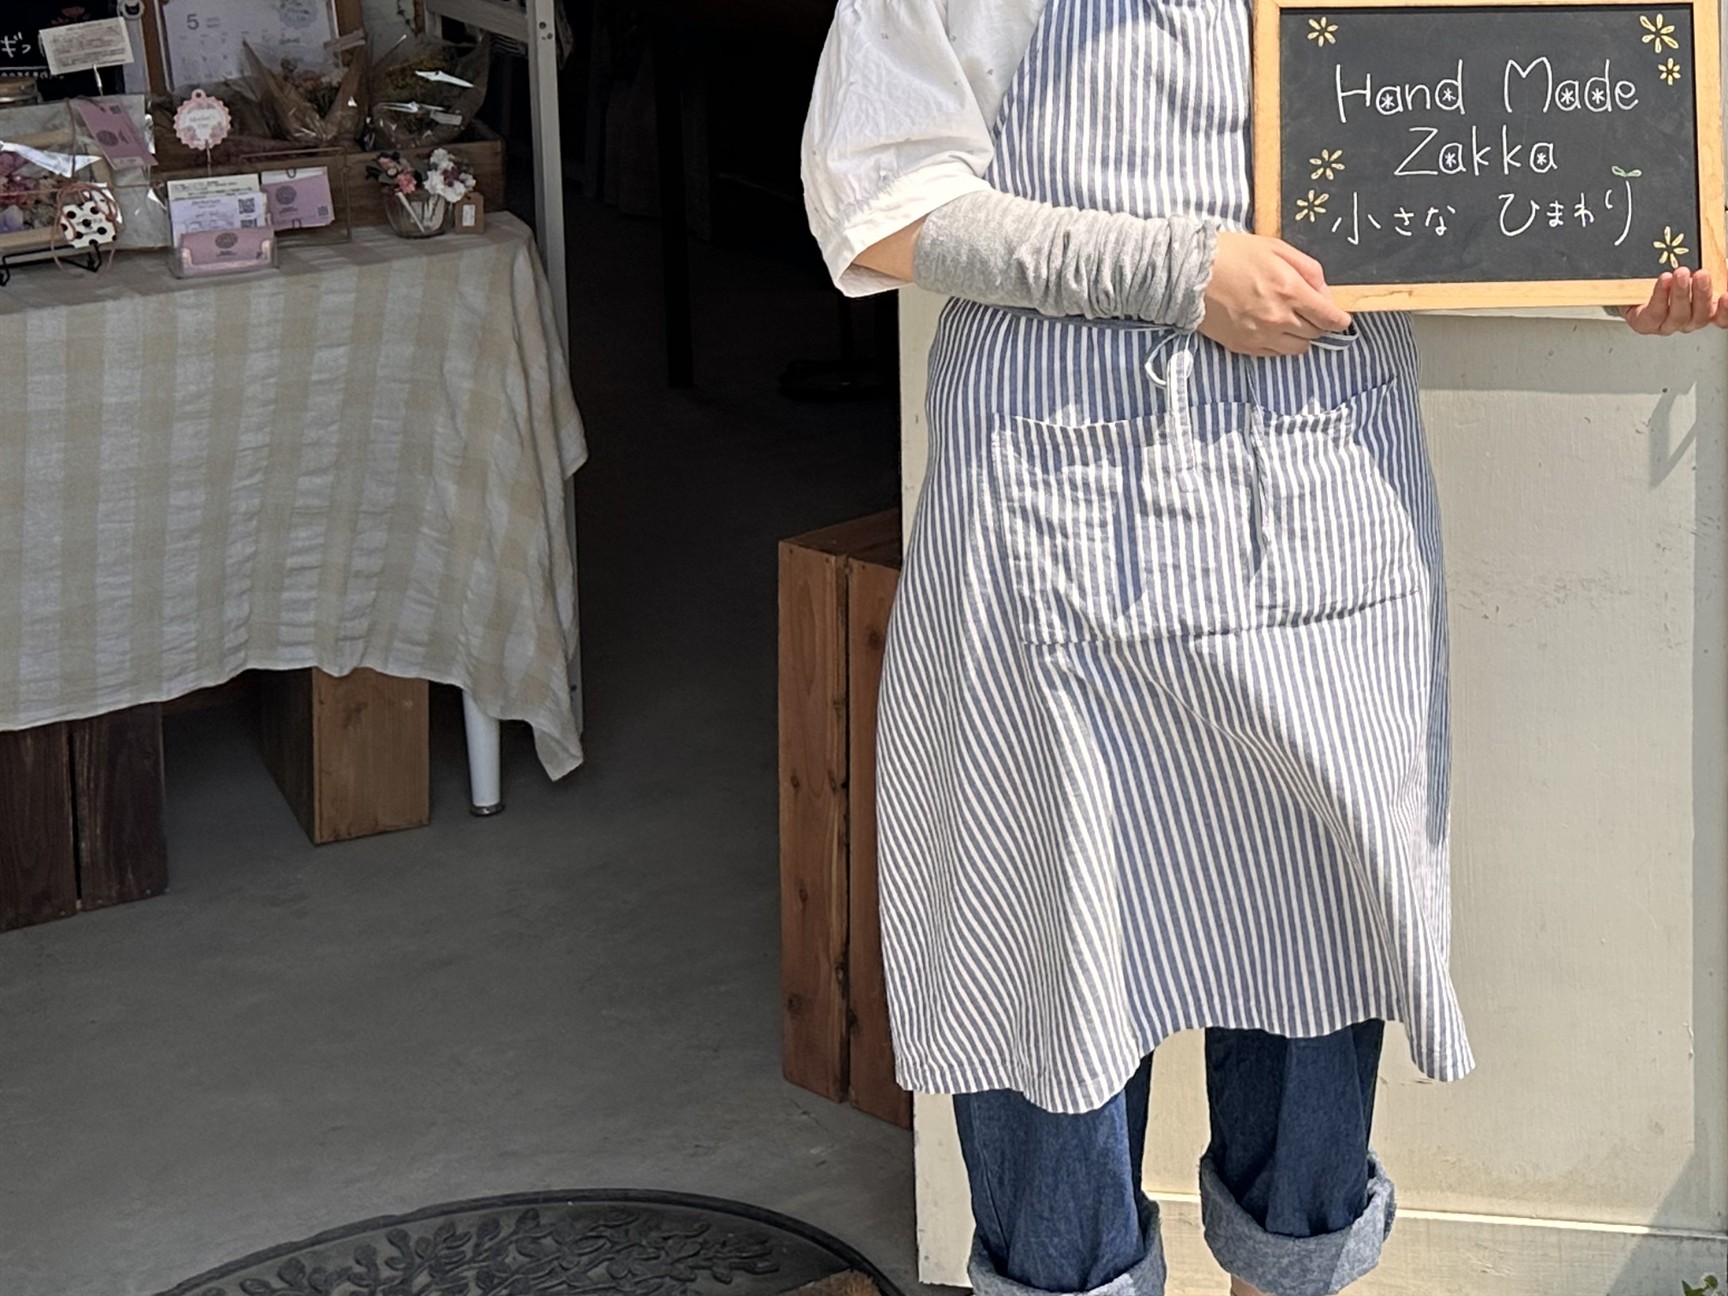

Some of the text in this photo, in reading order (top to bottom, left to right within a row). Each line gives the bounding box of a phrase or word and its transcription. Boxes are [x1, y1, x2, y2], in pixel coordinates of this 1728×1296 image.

[187, 13, 200, 31] 5
[1335, 56, 1640, 123] Hand Made
[1394, 125, 1557, 177] Zakka
[1331, 179, 1633, 246] 小さな ひまわり
